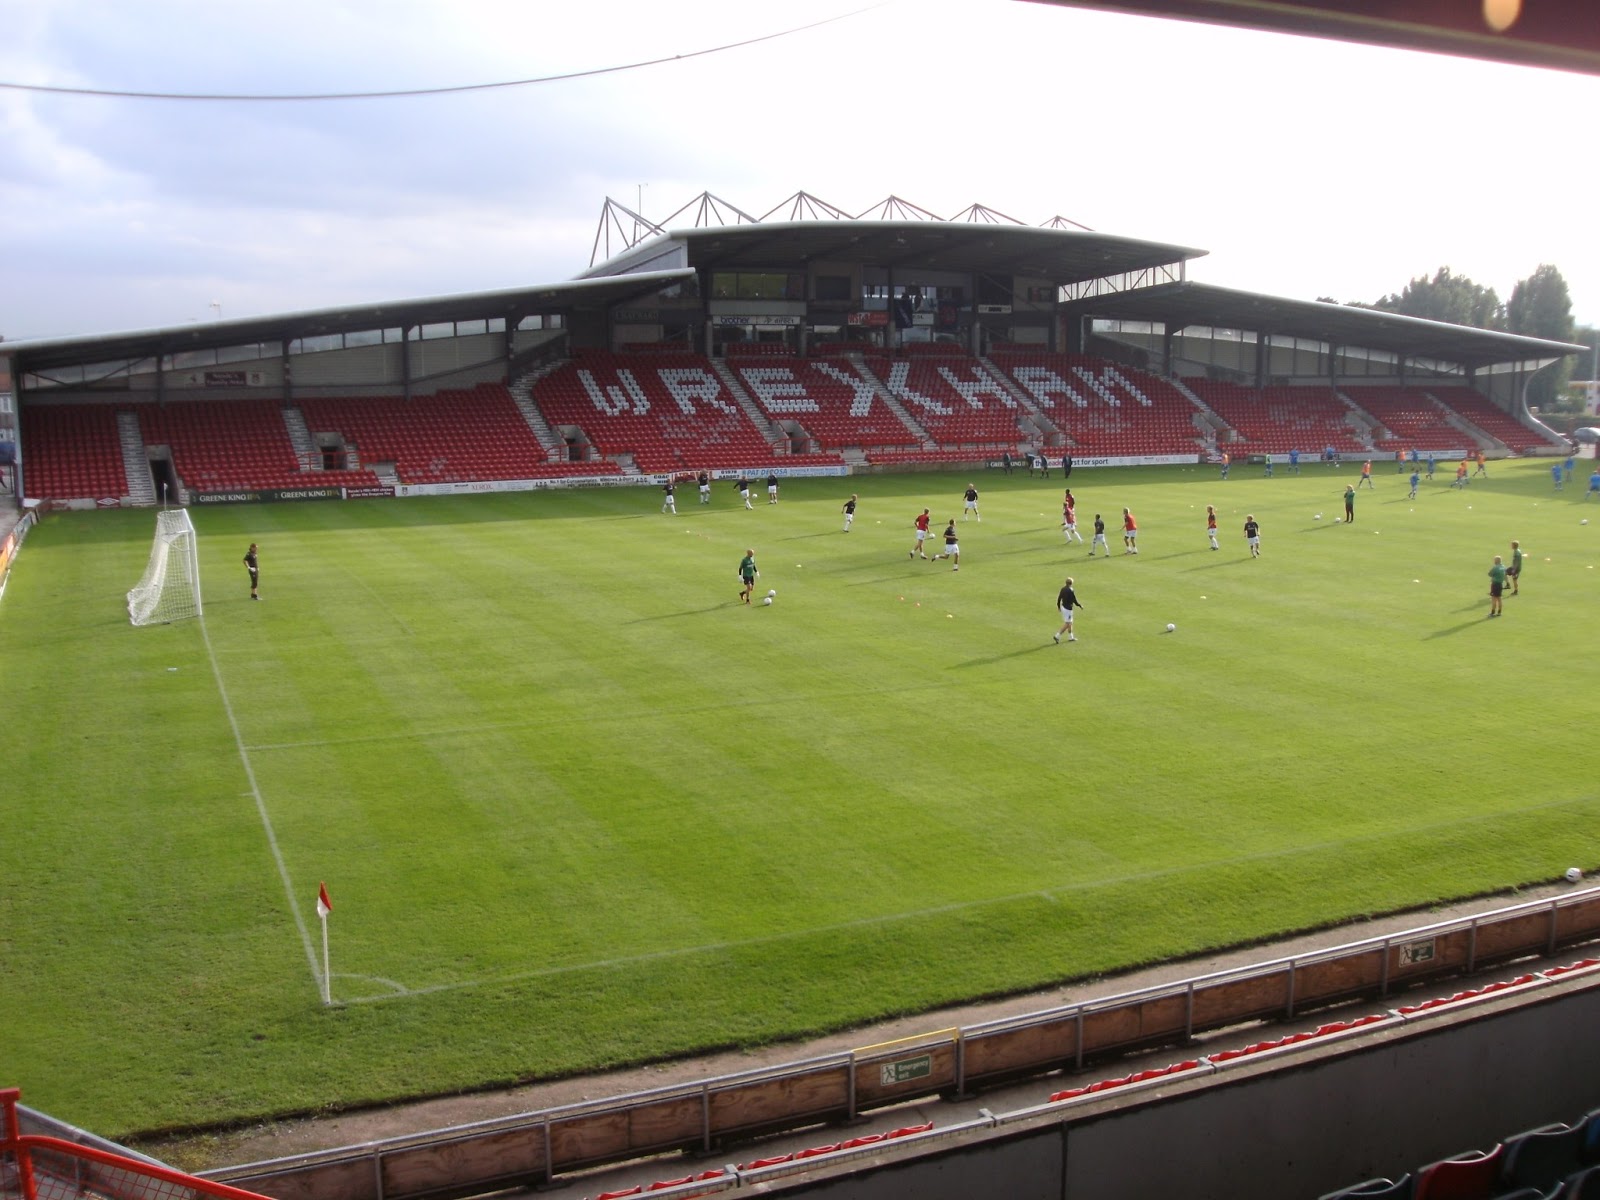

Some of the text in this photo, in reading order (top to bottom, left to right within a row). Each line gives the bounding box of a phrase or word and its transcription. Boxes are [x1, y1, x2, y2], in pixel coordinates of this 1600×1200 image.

[720, 316, 750, 324] brother
[576, 361, 1153, 416] WREXHAM
[199, 494, 228, 502] GREENE
[228, 493, 247, 501] KING
[280, 490, 308, 498] GREENE
[308, 489, 327, 497] KING
[898, 1060, 929, 1071] Emergency
[898, 1071, 909, 1079] exit
